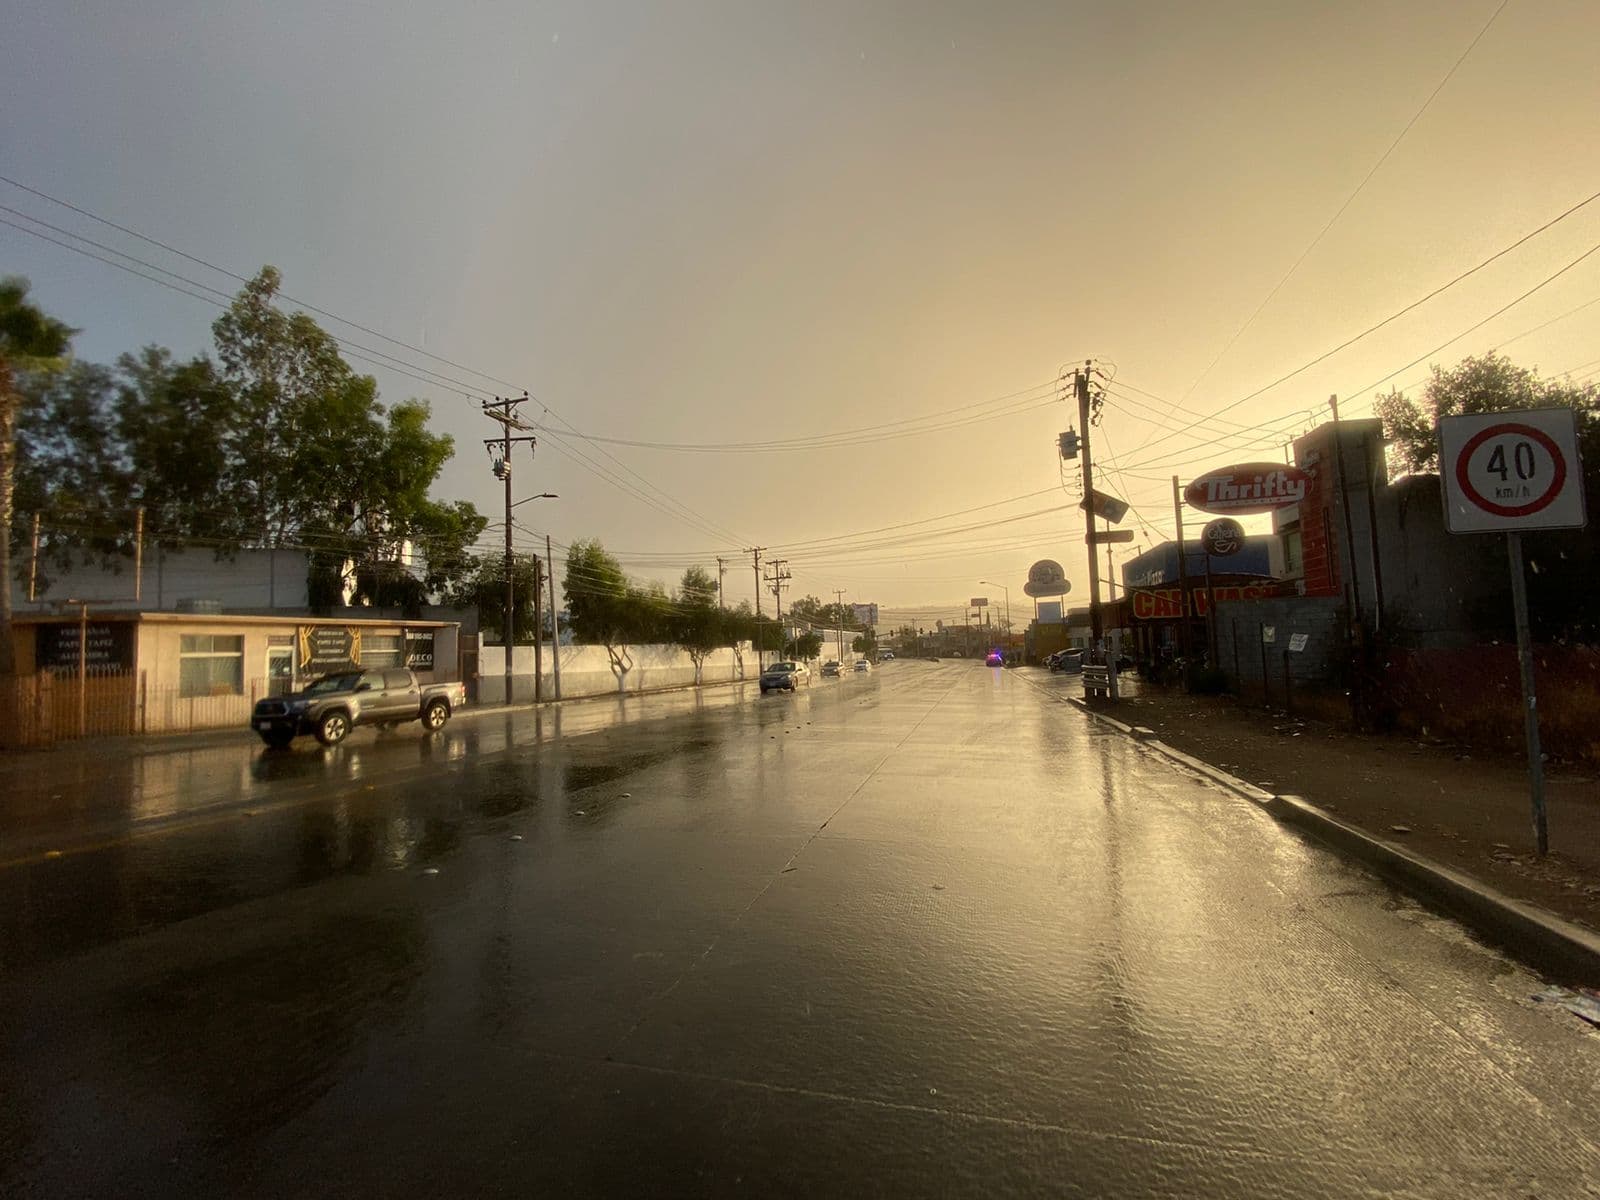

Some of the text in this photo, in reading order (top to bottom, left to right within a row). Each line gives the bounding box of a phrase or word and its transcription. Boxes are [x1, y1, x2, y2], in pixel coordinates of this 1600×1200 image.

[1486, 442, 1536, 481] 40
[1195, 471, 1305, 503] Thrifty
[1495, 486, 1531, 499] km/h
